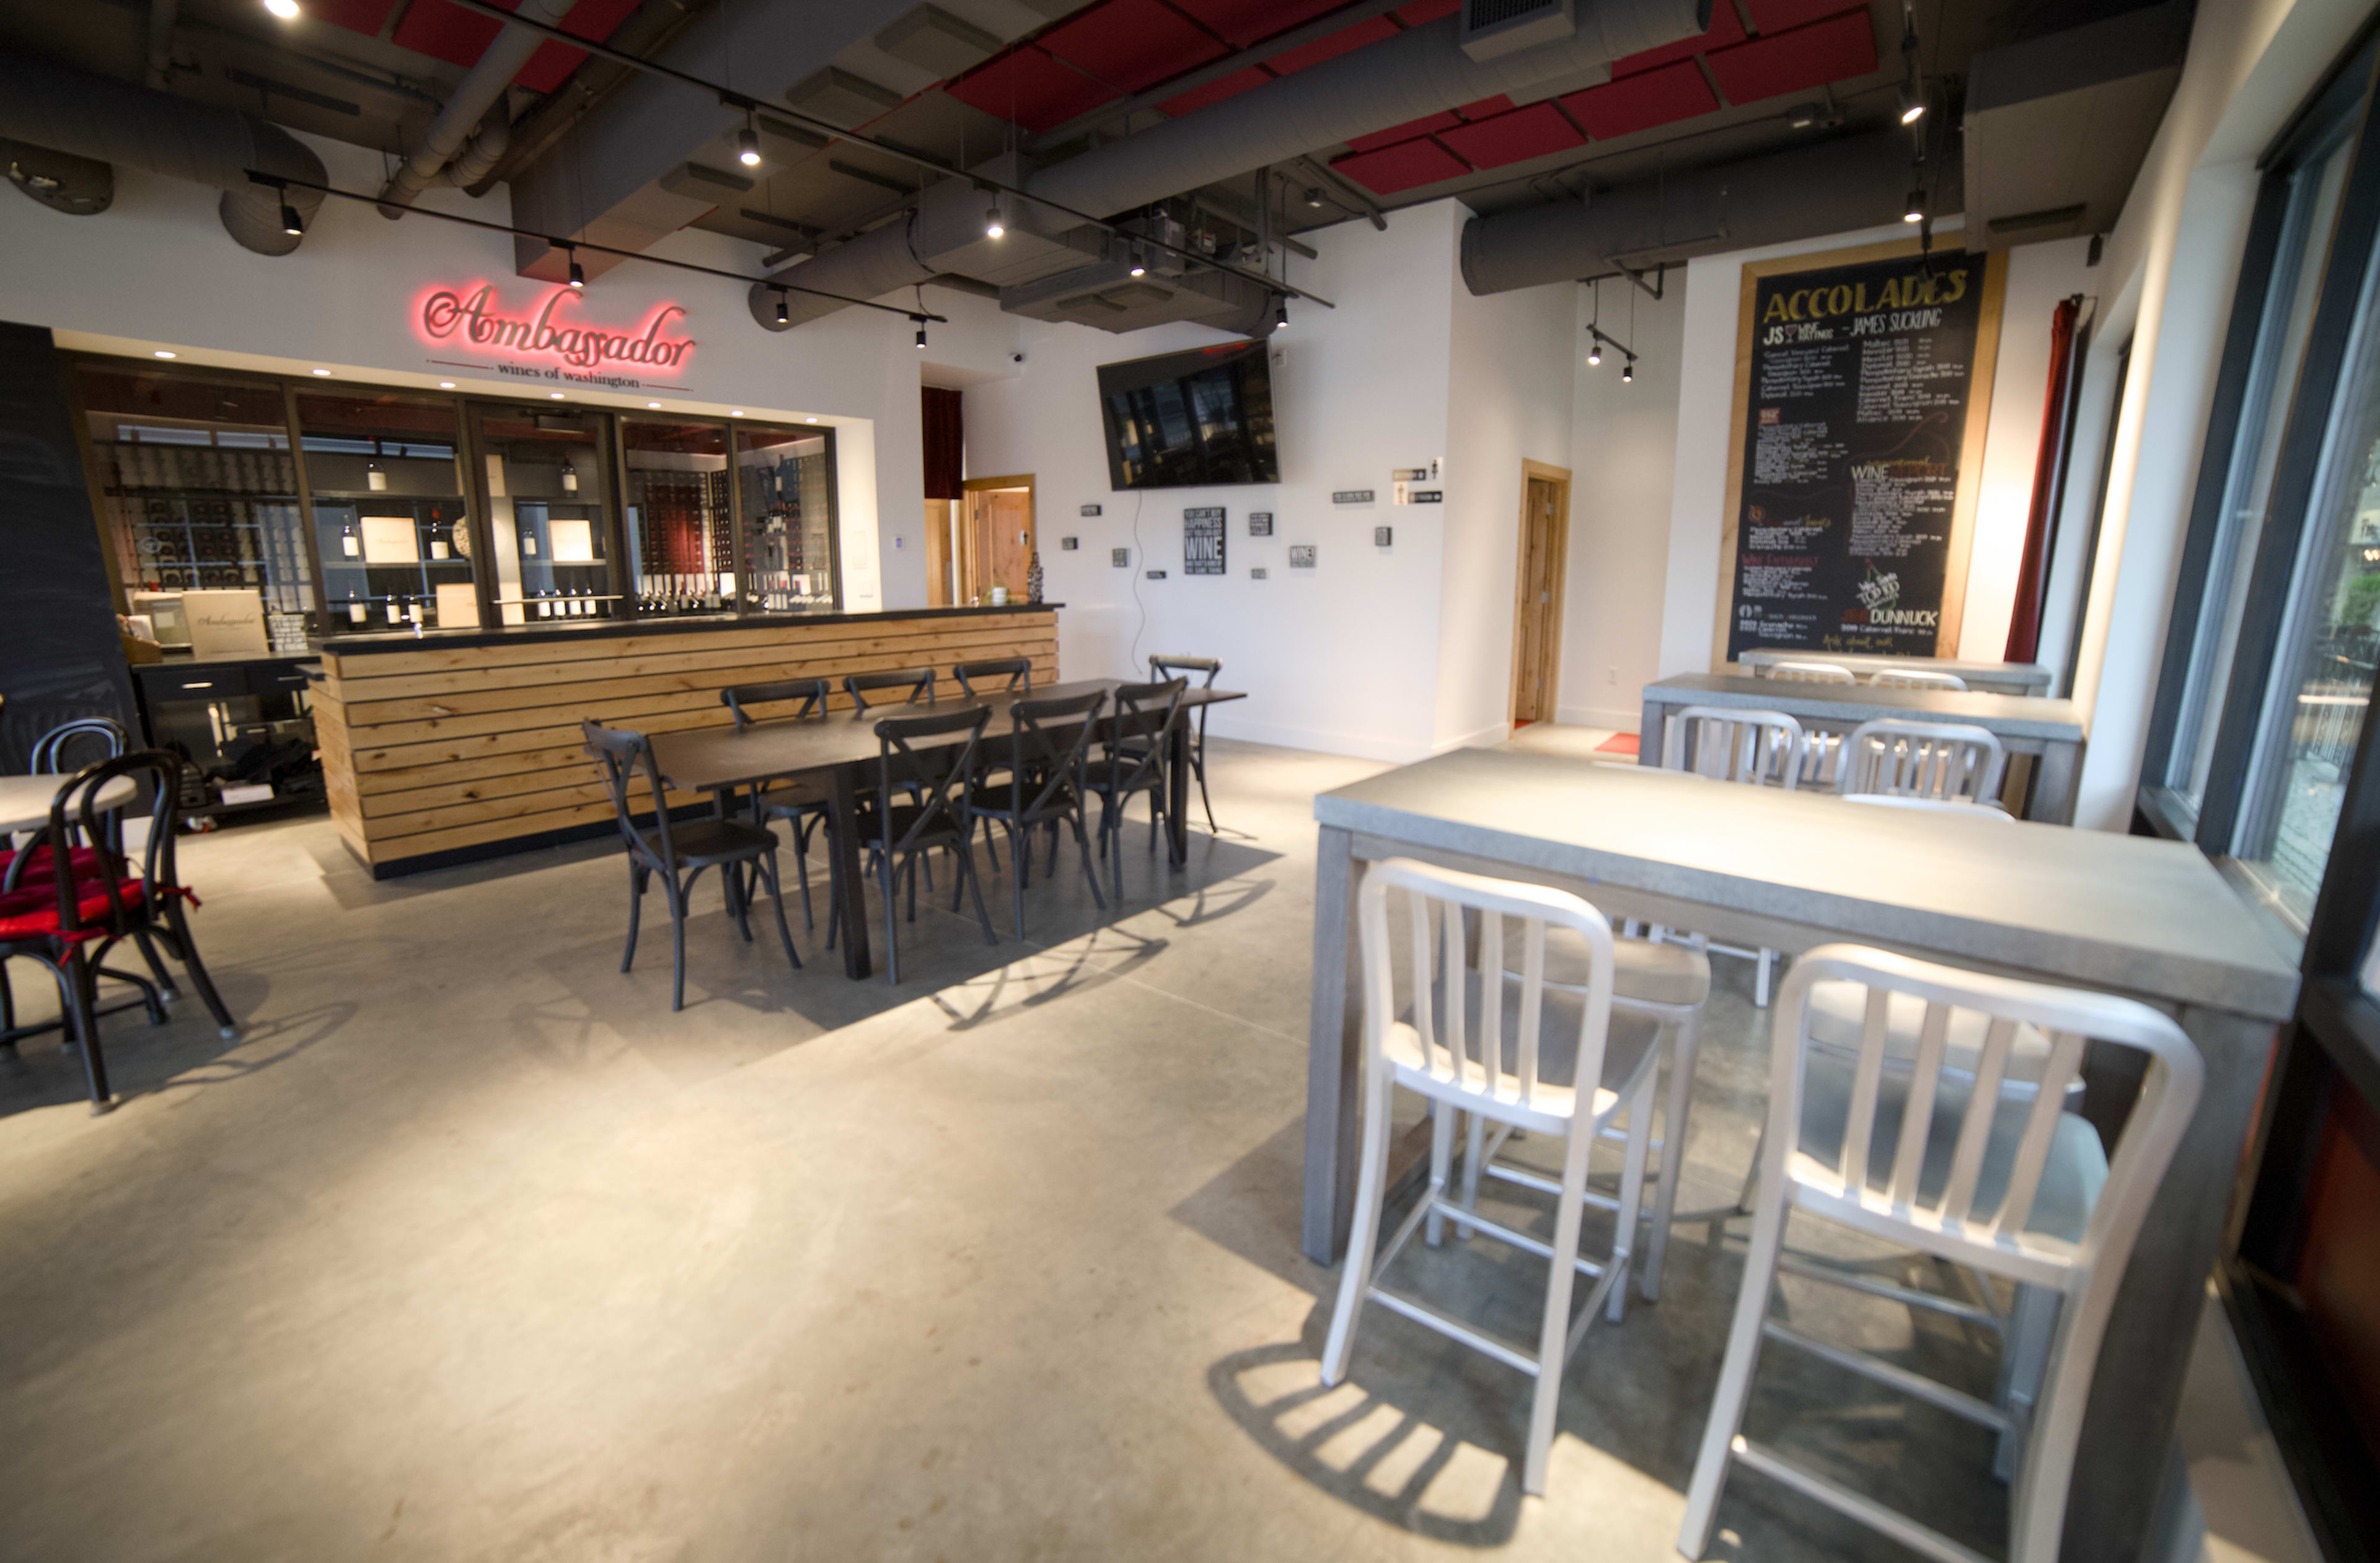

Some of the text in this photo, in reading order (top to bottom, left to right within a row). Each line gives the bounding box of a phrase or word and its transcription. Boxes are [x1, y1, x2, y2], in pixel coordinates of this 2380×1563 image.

[1763, 269, 1968, 324] ACCOLADES
[424, 284, 696, 368] Ambassador
[1849, 307, 1943, 337] JAMES SUCKLING
[1763, 325, 1784, 345] JS
[498, 361, 640, 389] wines of washington
[1851, 464, 1889, 479] WINE
[1185, 517, 1222, 528] HAPPINESS
[1185, 537, 1222, 559] WINE
[1870, 609, 1939, 627] DUNNUCK
